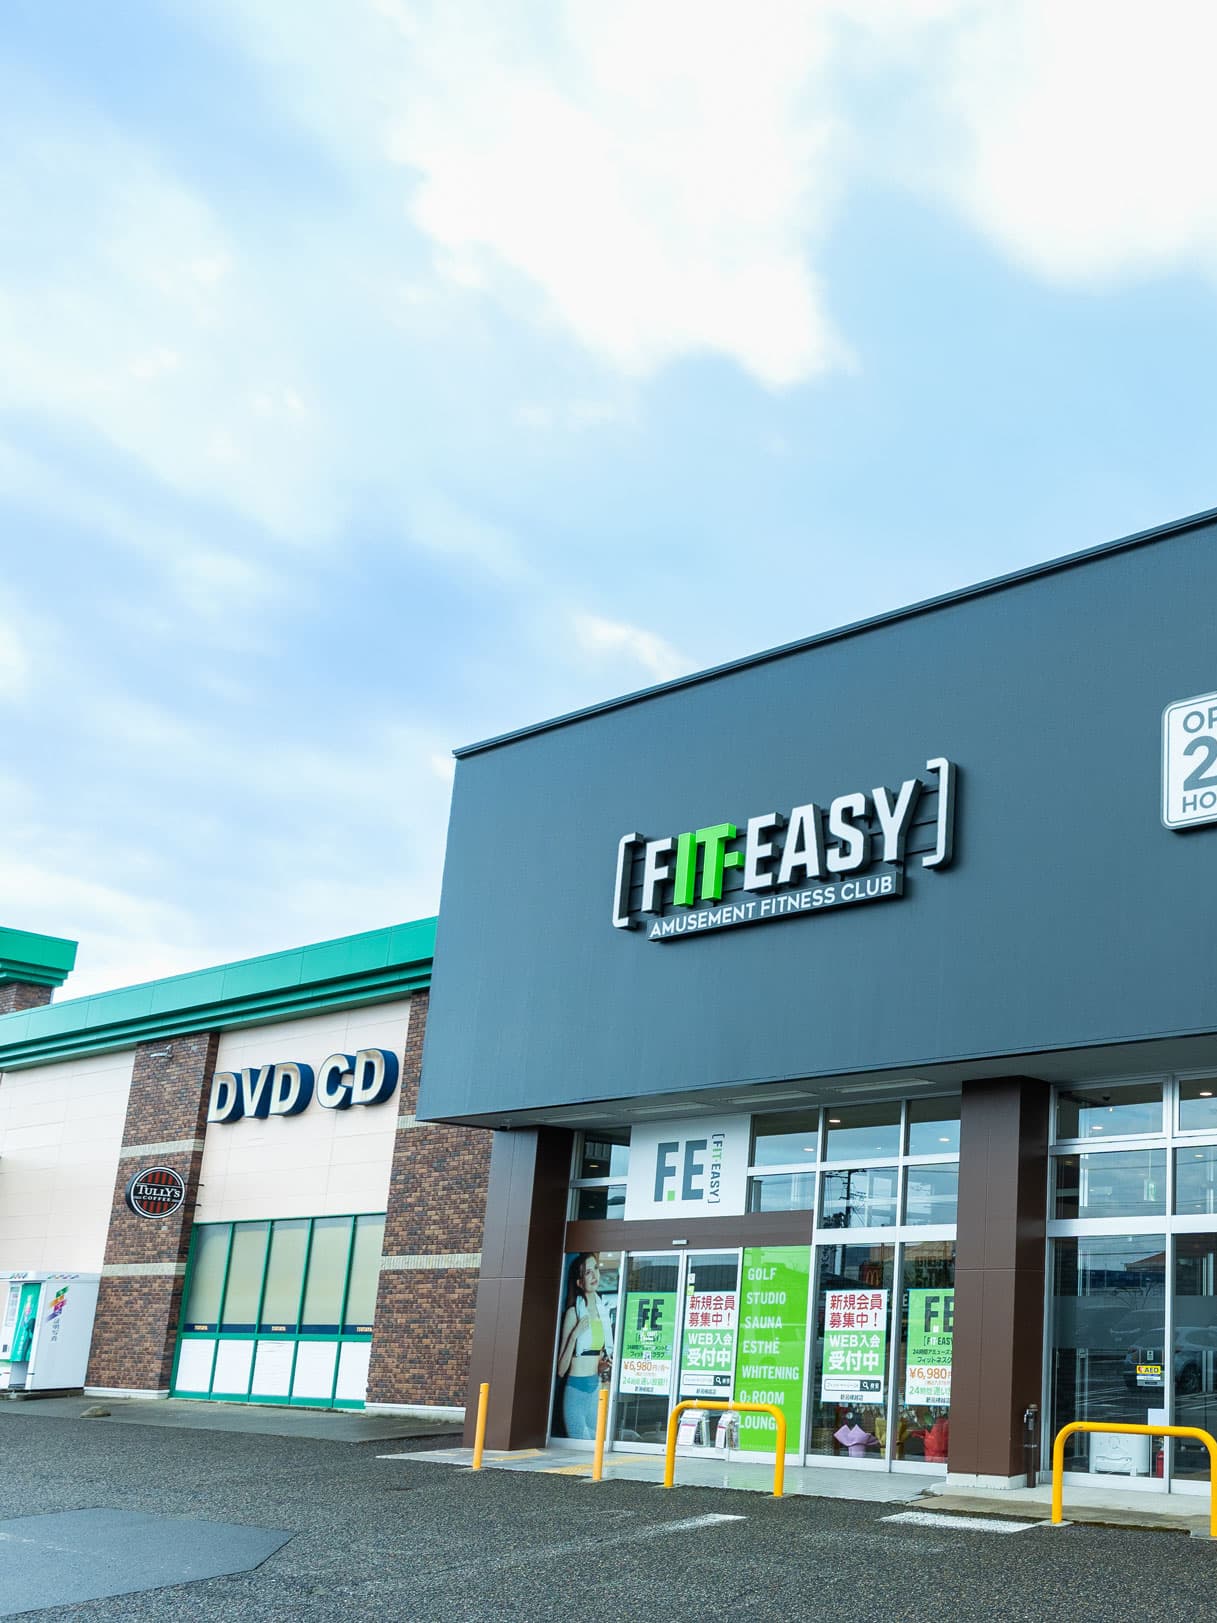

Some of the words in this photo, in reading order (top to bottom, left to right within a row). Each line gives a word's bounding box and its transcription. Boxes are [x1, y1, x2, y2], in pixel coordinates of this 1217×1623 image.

[650, 902, 757, 940] AMUSEMENT
[760, 887, 836, 918] FITNESS
[840, 875, 894, 901] CLUB
[207, 1061, 315, 1124] DVD
[316, 1048, 399, 1110] CD
[136, 1184, 181, 1198] TULLY'S
[747, 1267, 777, 1281] GOLF
[688, 1295, 736, 1312] 新規会員
[746, 1291, 787, 1305] STUDIO
[829, 1293, 883, 1311] 新規会員
[743, 1316, 783, 1329] SAUNA
[687, 1332, 732, 1346] WEB入会
[828, 1333, 881, 1348] WEB入会
[686, 1347, 732, 1369] 受付中
[828, 1350, 880, 1372] 受付中
[741, 1364, 800, 1381] WHITENING
[738, 1415, 778, 1430] LOUNG
